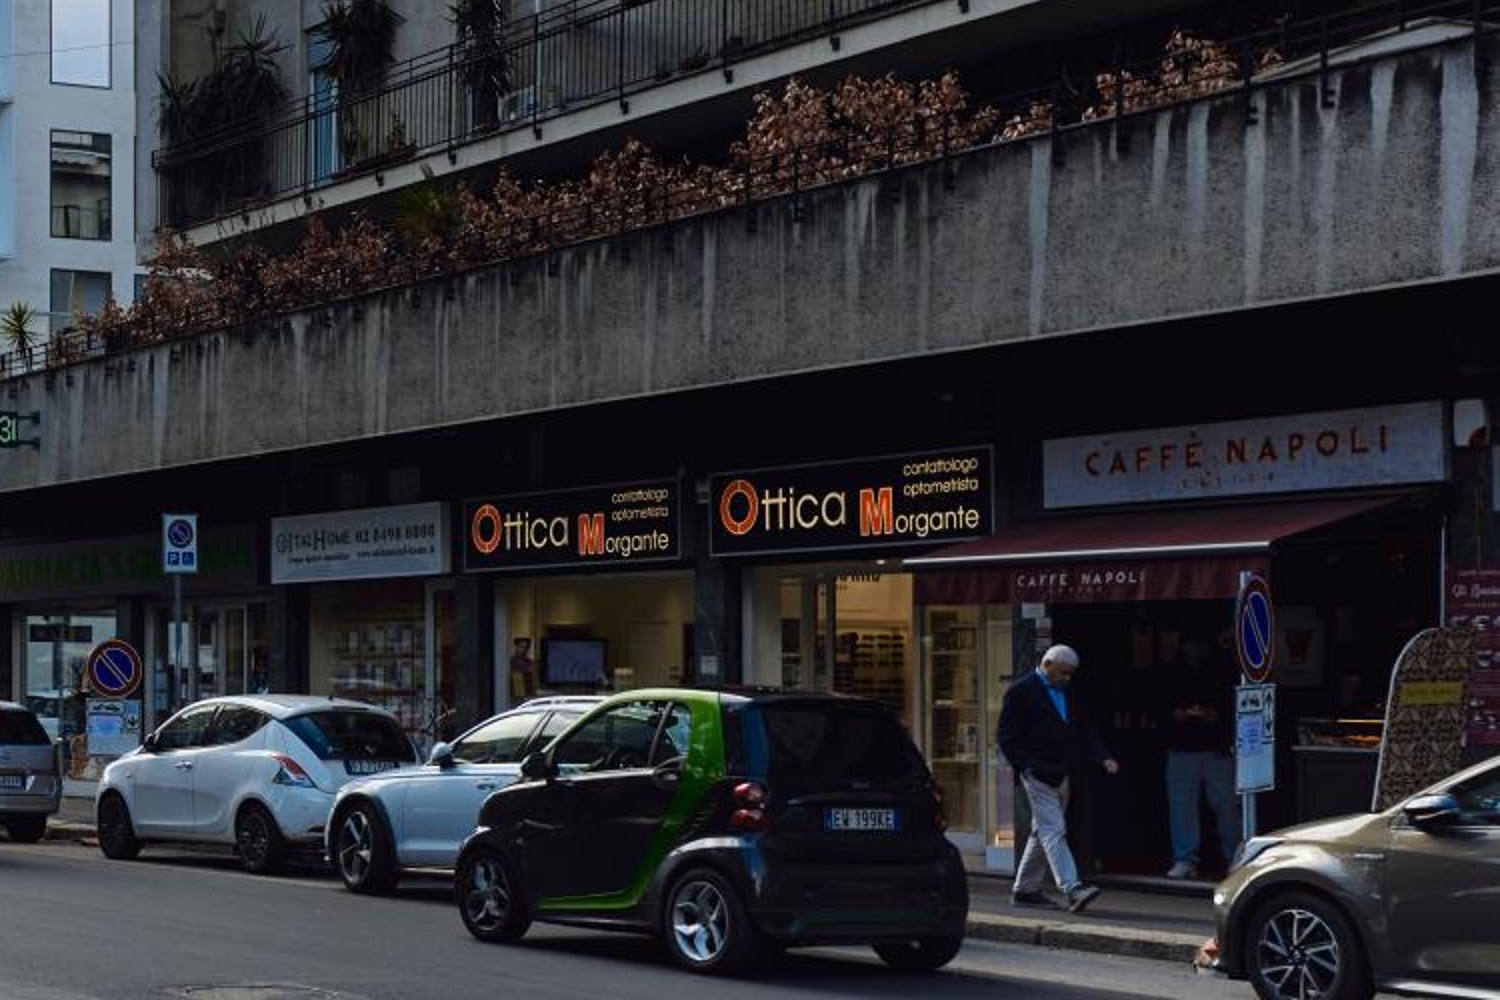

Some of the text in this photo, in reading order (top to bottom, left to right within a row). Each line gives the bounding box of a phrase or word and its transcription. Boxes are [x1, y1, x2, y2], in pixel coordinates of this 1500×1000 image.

[1226, 424, 1388, 463] NAPOLI
[903, 457, 979, 477] contattologo
[611, 488, 669, 504] contattologo
[903, 477, 979, 498] optometrista
[611, 505, 669, 521] optometrista
[719, 479, 980, 537] Ottica Morgante
[472, 503, 669, 557] Ottica Morgante
[1080, 570, 1146, 586] NAPOLI
